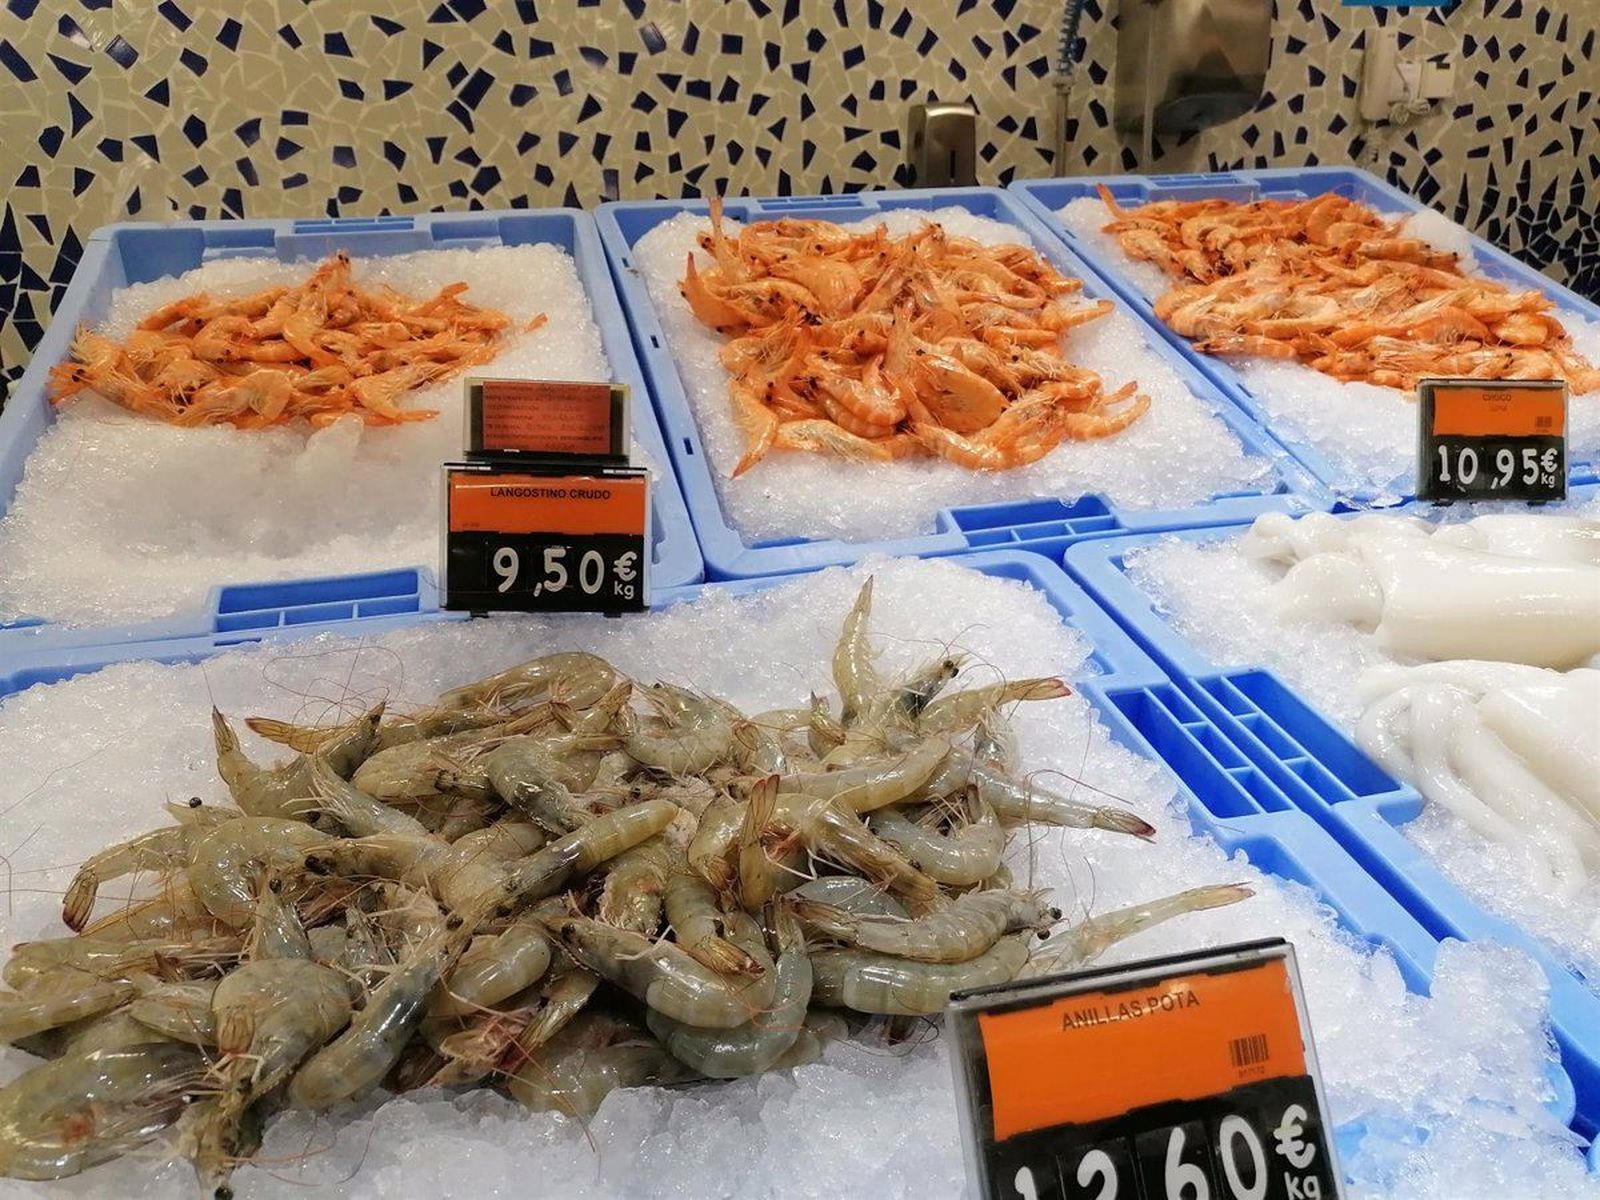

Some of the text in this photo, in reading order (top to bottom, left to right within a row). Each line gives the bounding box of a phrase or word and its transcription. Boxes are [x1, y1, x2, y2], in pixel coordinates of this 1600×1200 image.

[1541, 474, 1556, 488] kg
[490, 486, 611, 500] LANGOSTINO CRUDO
[614, 581, 635, 599] kg
[1061, 989, 1200, 1032] ANILLAS POTA
